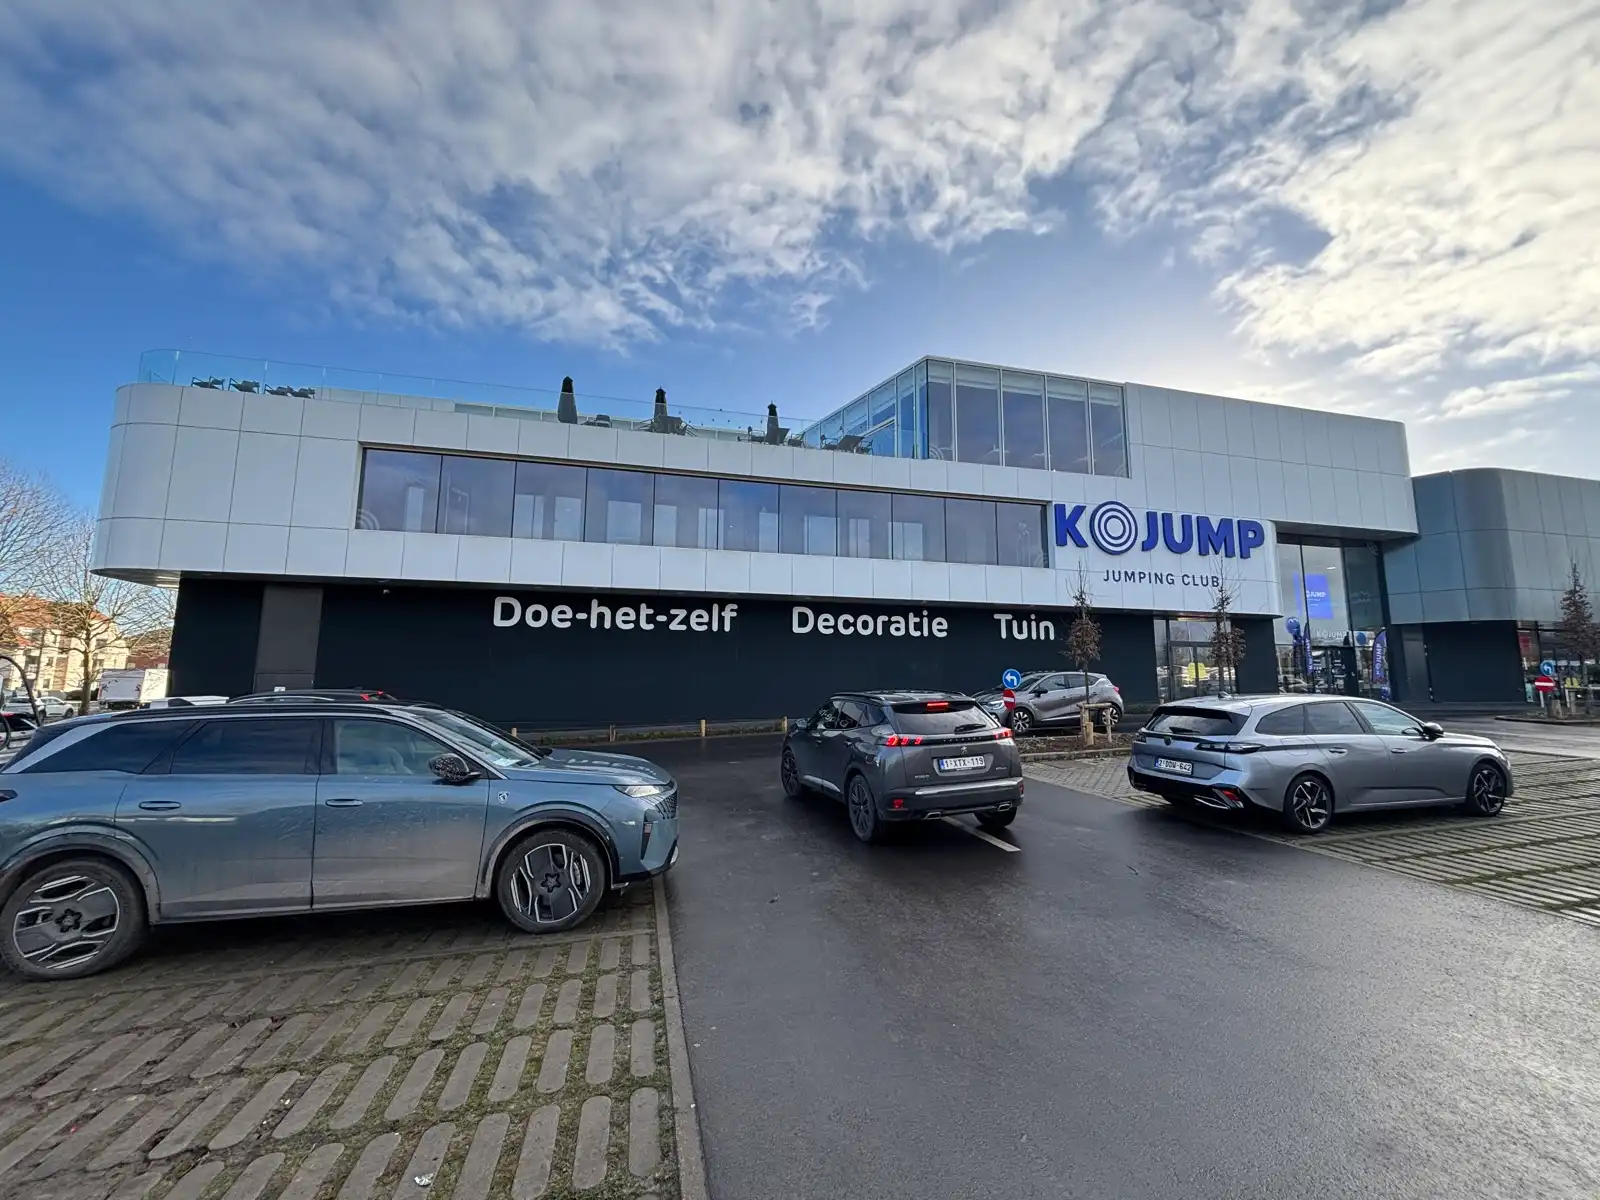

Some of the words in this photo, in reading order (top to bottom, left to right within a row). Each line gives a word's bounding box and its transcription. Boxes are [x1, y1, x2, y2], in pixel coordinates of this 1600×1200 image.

[1054, 501, 1265, 559] KOJUMP
[1104, 570, 1175, 585] JUMPING
[1182, 575, 1220, 588] CLUB
[493, 597, 738, 633] Doe-het-zelf
[792, 607, 949, 639] Decoratie
[994, 613, 1055, 642] Tuin
